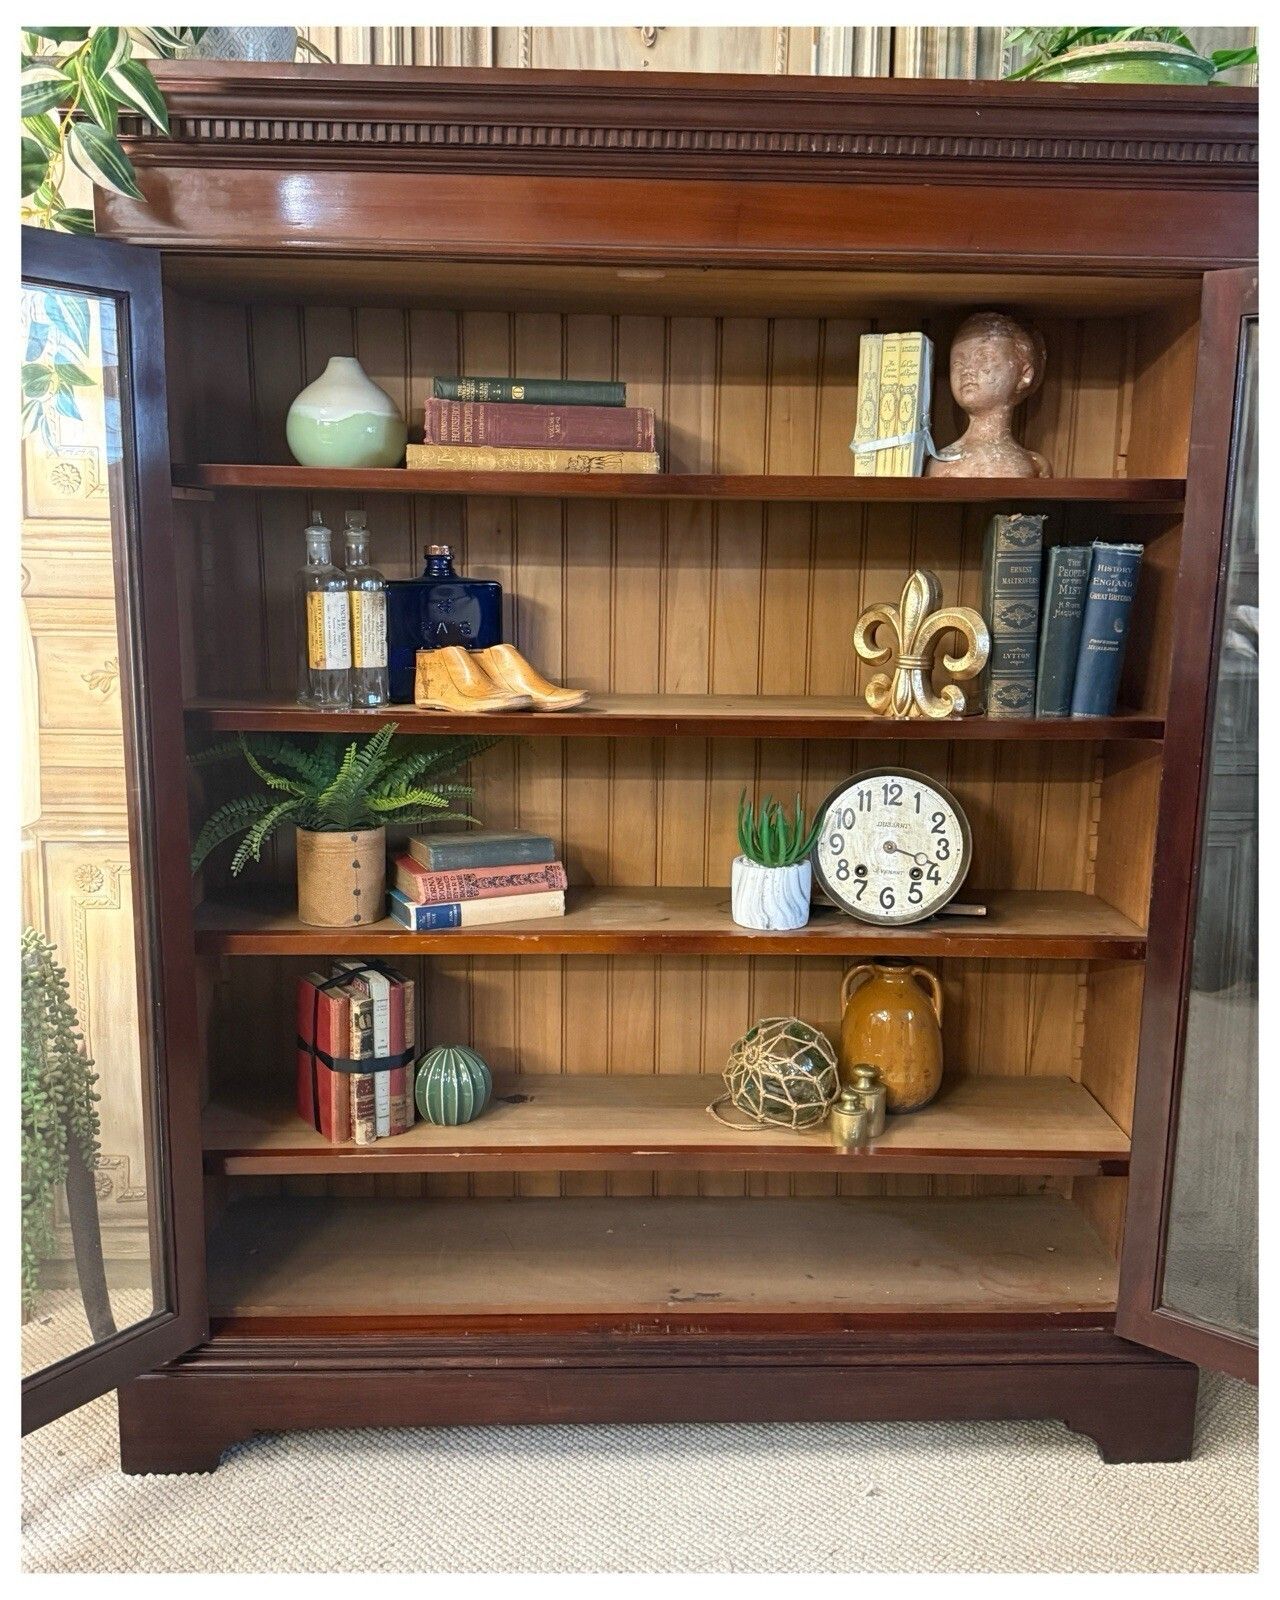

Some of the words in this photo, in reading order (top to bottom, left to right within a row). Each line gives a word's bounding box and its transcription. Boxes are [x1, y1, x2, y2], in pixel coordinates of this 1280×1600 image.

[1058, 566, 1086, 577] PEOPLE
[1098, 564, 1133, 573] HISTORY
[1058, 584, 1082, 595] MIST
[1093, 577, 1132, 588] ENGLAND
[858, 790, 872, 812] 11
[882, 783, 903, 806] 12
[914, 791, 921, 814] 1
[835, 808, 856, 830] 10
[931, 812, 946, 834] 2
[829, 833, 845, 855] 9
[936, 838, 950, 860] 3
[836, 859, 849, 880] 8
[927, 863, 941, 885] 4
[428, 877, 438, 901] LORNA
[436, 876, 446, 900] DOONE
[854, 879, 868, 901] 7
[880, 887, 895, 909] 6
[908, 882, 922, 903] 5
